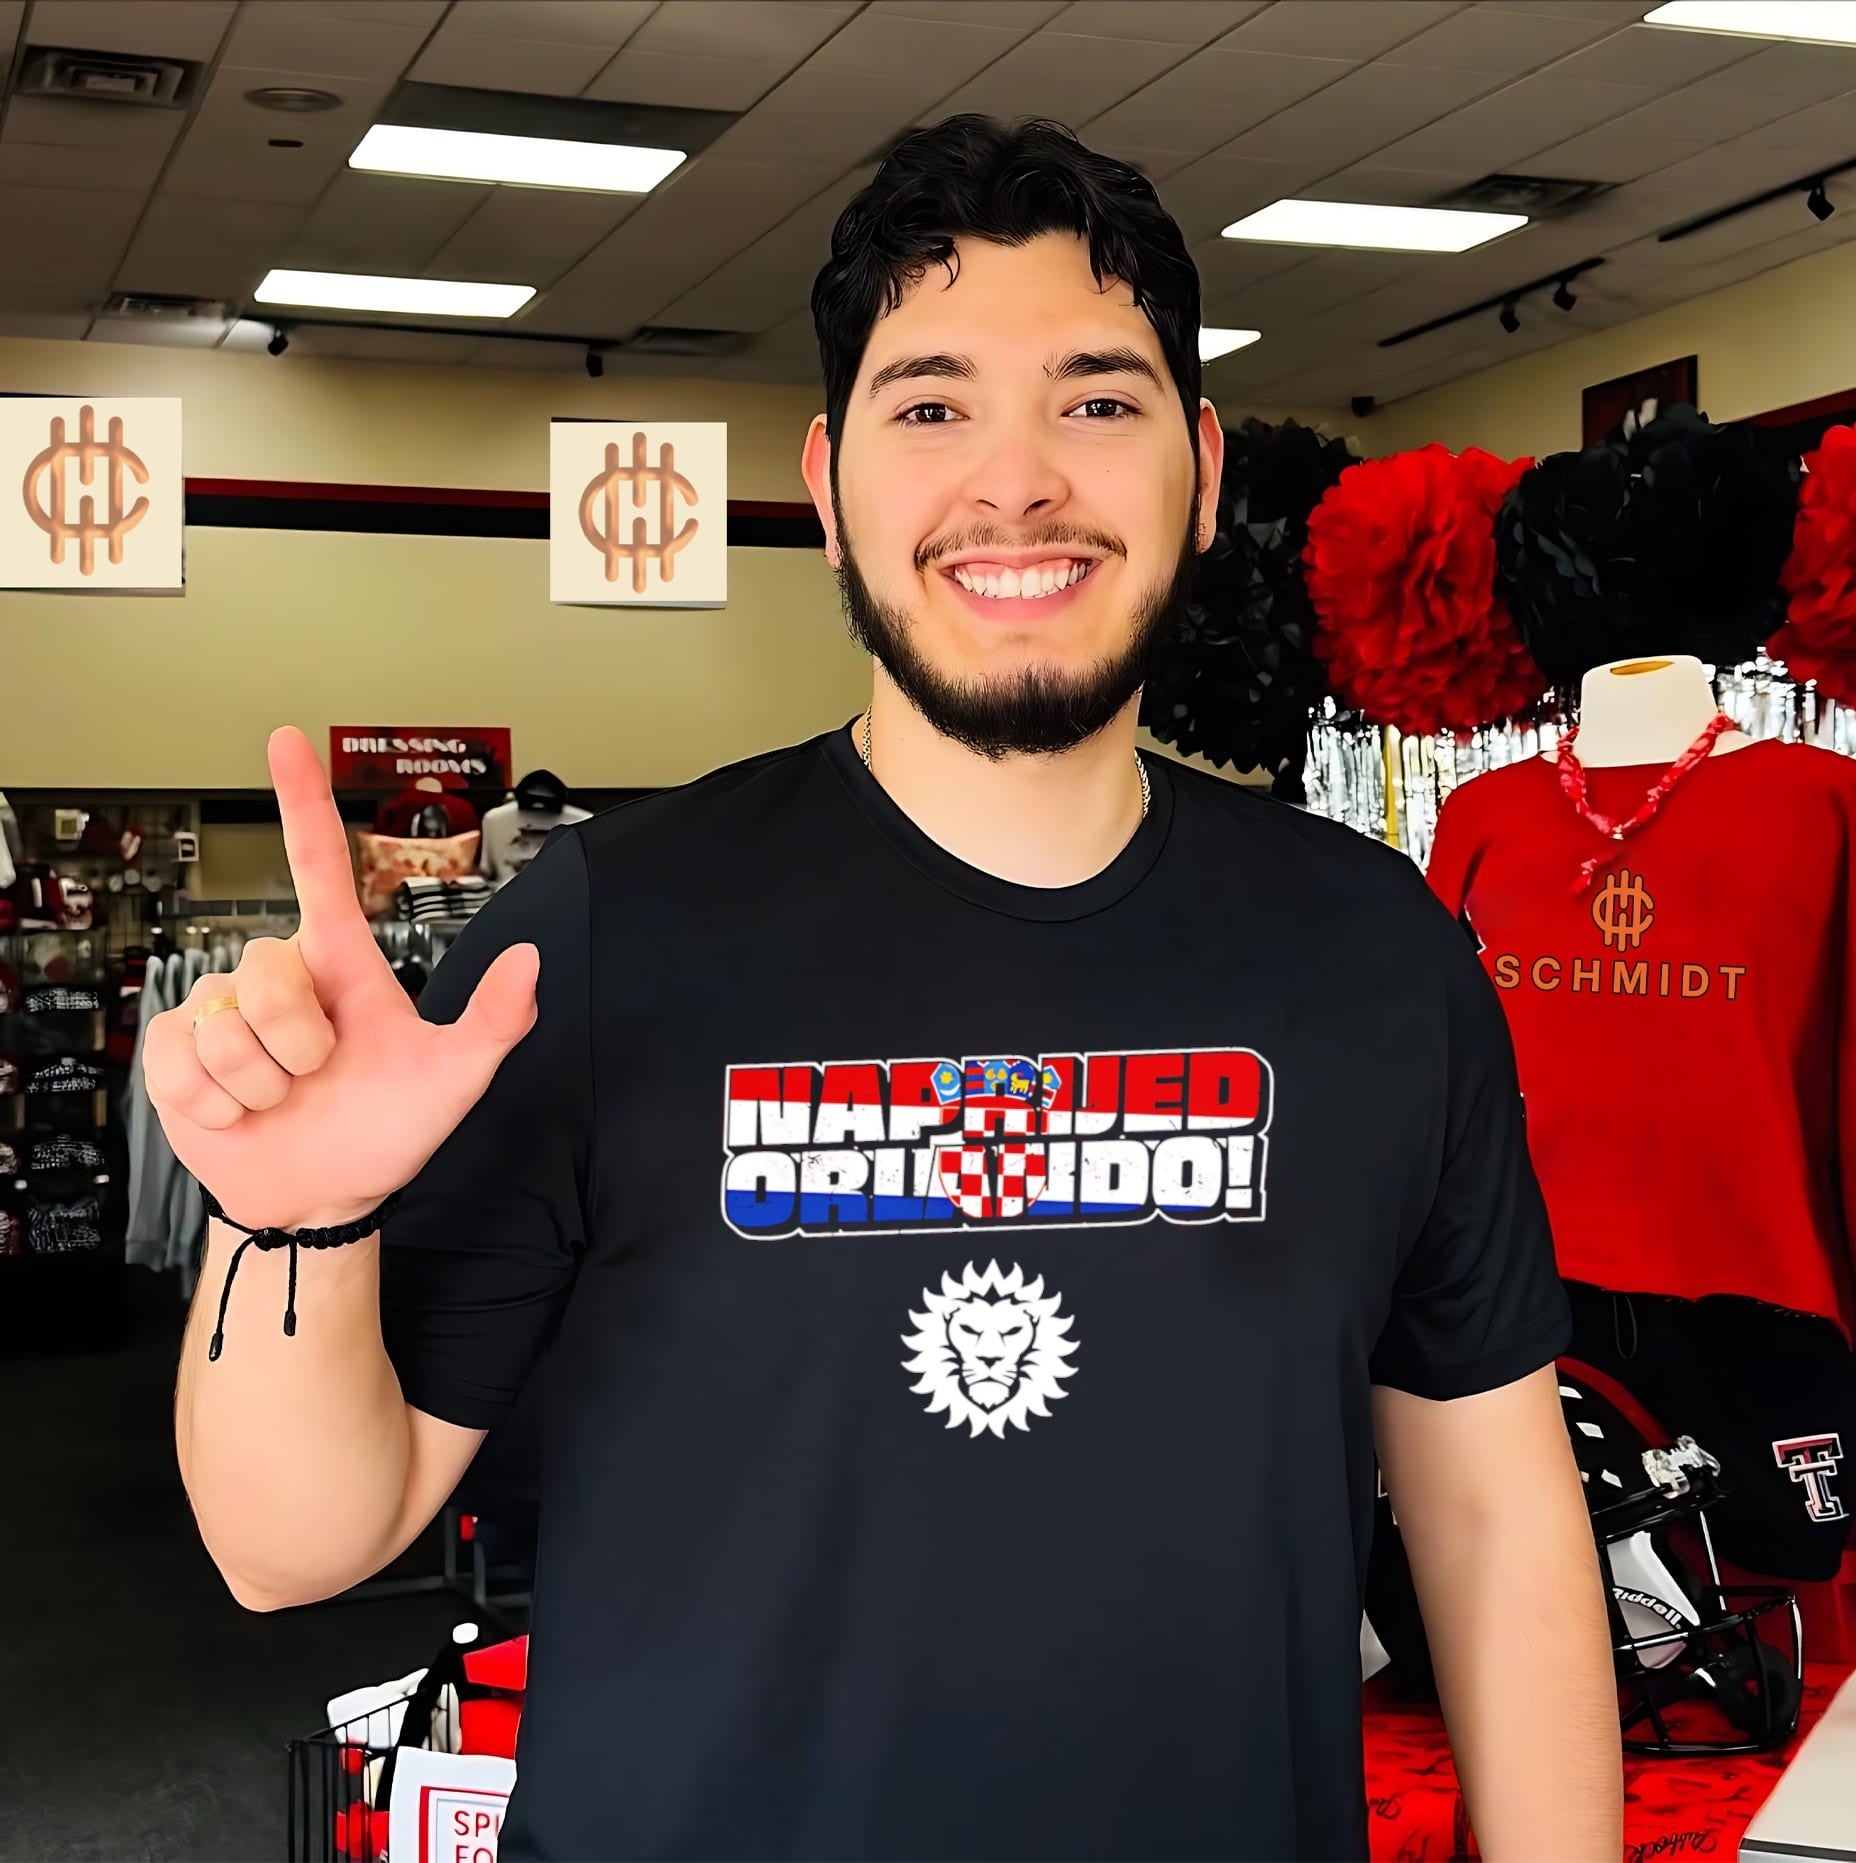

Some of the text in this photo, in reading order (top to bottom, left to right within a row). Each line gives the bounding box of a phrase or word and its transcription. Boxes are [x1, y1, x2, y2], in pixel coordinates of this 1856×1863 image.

[396, 758, 488, 775] ROOMS
[1493, 953, 1748, 1000] SCHMIDT
[727, 1052, 1262, 1147] NAPRIJED
[724, 1135, 1255, 1228] ORLANDO!
